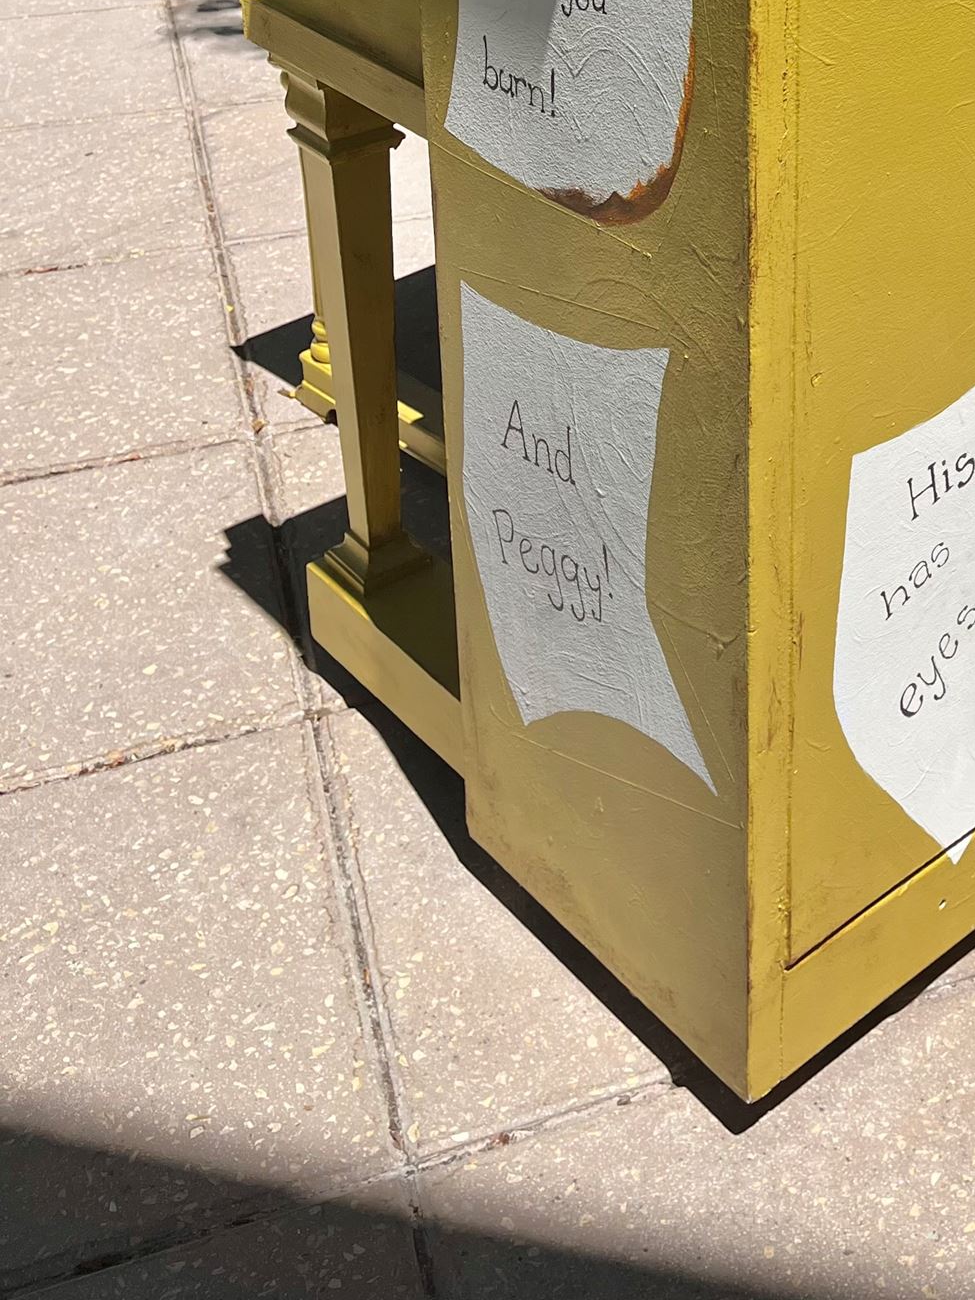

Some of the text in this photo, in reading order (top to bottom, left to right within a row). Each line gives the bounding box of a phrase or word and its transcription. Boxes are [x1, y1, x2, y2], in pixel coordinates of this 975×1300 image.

[482, 35, 556, 117] burn!
[500, 400, 576, 484] And
[492, 508, 614, 622] Peggy!
[880, 541, 951, 620] has
